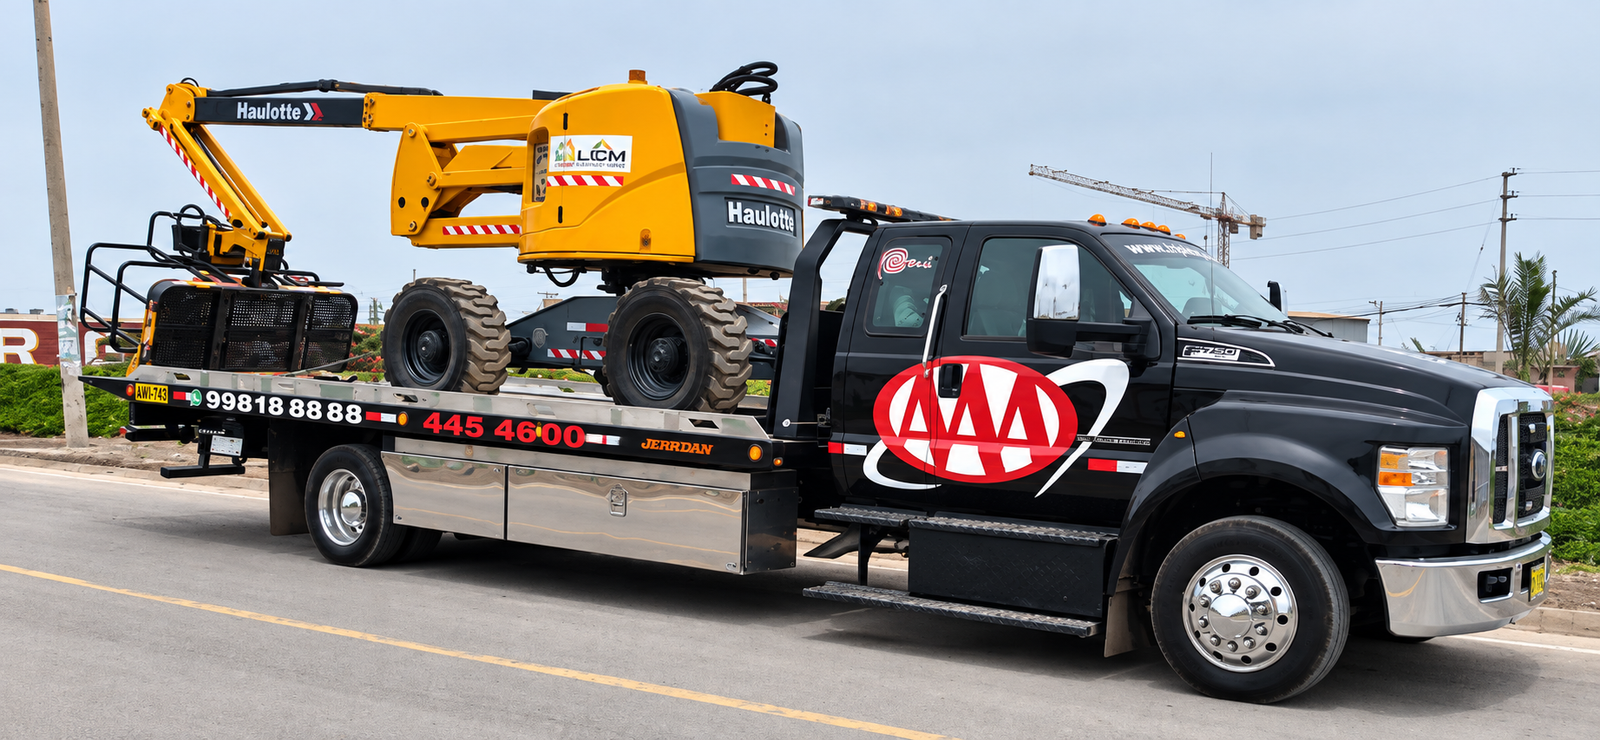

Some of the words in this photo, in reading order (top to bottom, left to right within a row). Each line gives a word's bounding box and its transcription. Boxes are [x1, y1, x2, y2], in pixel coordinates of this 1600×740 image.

[236, 102, 301, 120] Haulotte
[727, 201, 794, 233] Haulotte
[136, 385, 167, 402] AWI-743
[422, 411, 484, 437] 445
[494, 418, 585, 448] 4600
[886, 363, 1060, 477] AAA
[641, 438, 714, 456] JERRDAN
